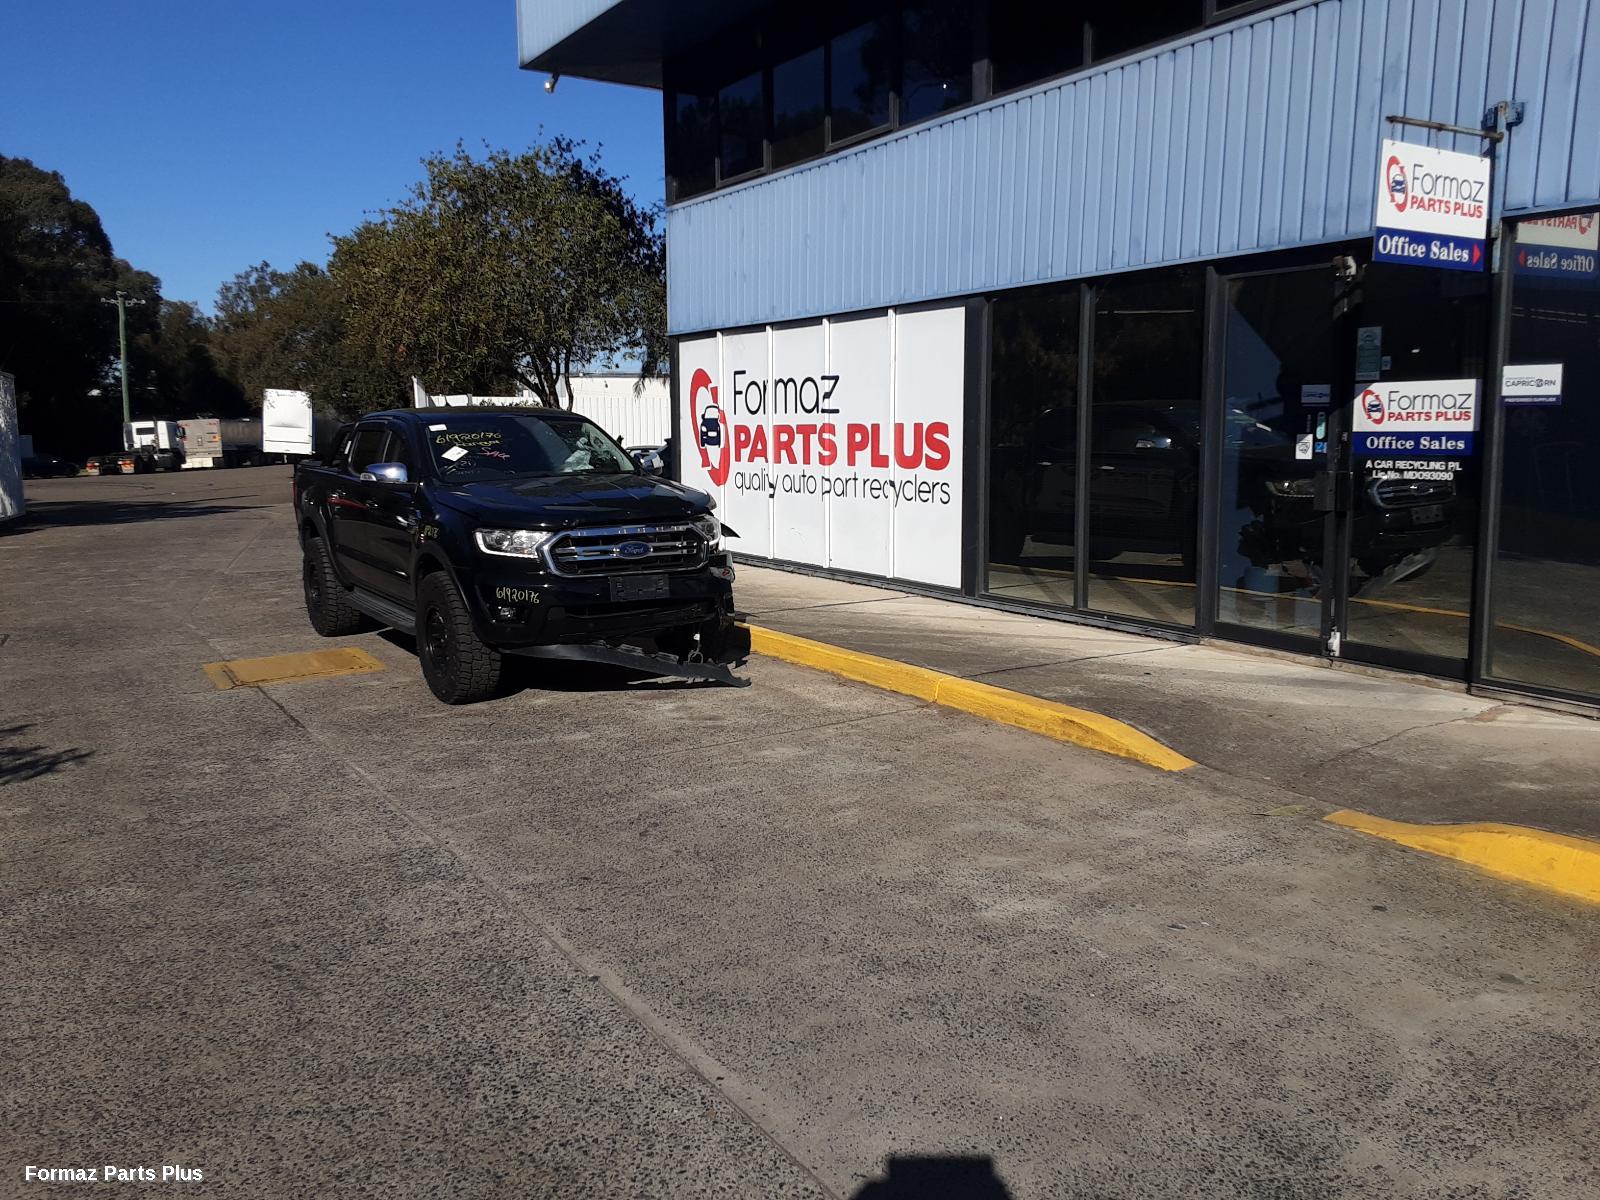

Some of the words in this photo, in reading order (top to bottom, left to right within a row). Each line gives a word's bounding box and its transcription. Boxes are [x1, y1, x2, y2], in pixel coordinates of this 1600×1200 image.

[1411, 163, 1485, 204] Formaz
[1410, 194, 1451, 214] PARTS
[1453, 201, 1484, 219] PLUS
[1378, 234, 1427, 258] Office
[1430, 240, 1470, 263] Sales
[733, 370, 840, 415] Formaz
[1387, 390, 1473, 411] Formaz
[1387, 412, 1433, 422] PARTS
[1435, 410, 1472, 421] PLUS
[734, 423, 838, 466] PARTS
[847, 421, 951, 471] PLUS
[1366, 436, 1415, 450] Office
[1419, 436, 1465, 450] Sales
[1365, 460, 1373, 469] A
[1373, 460, 1394, 470] CAR
[1394, 460, 1446, 471] RECYCLING
[782, 468, 817, 494] auto
[821, 471, 858, 502] part
[862, 473, 951, 508] recyclers
[495, 586, 540, 604] 61920176
